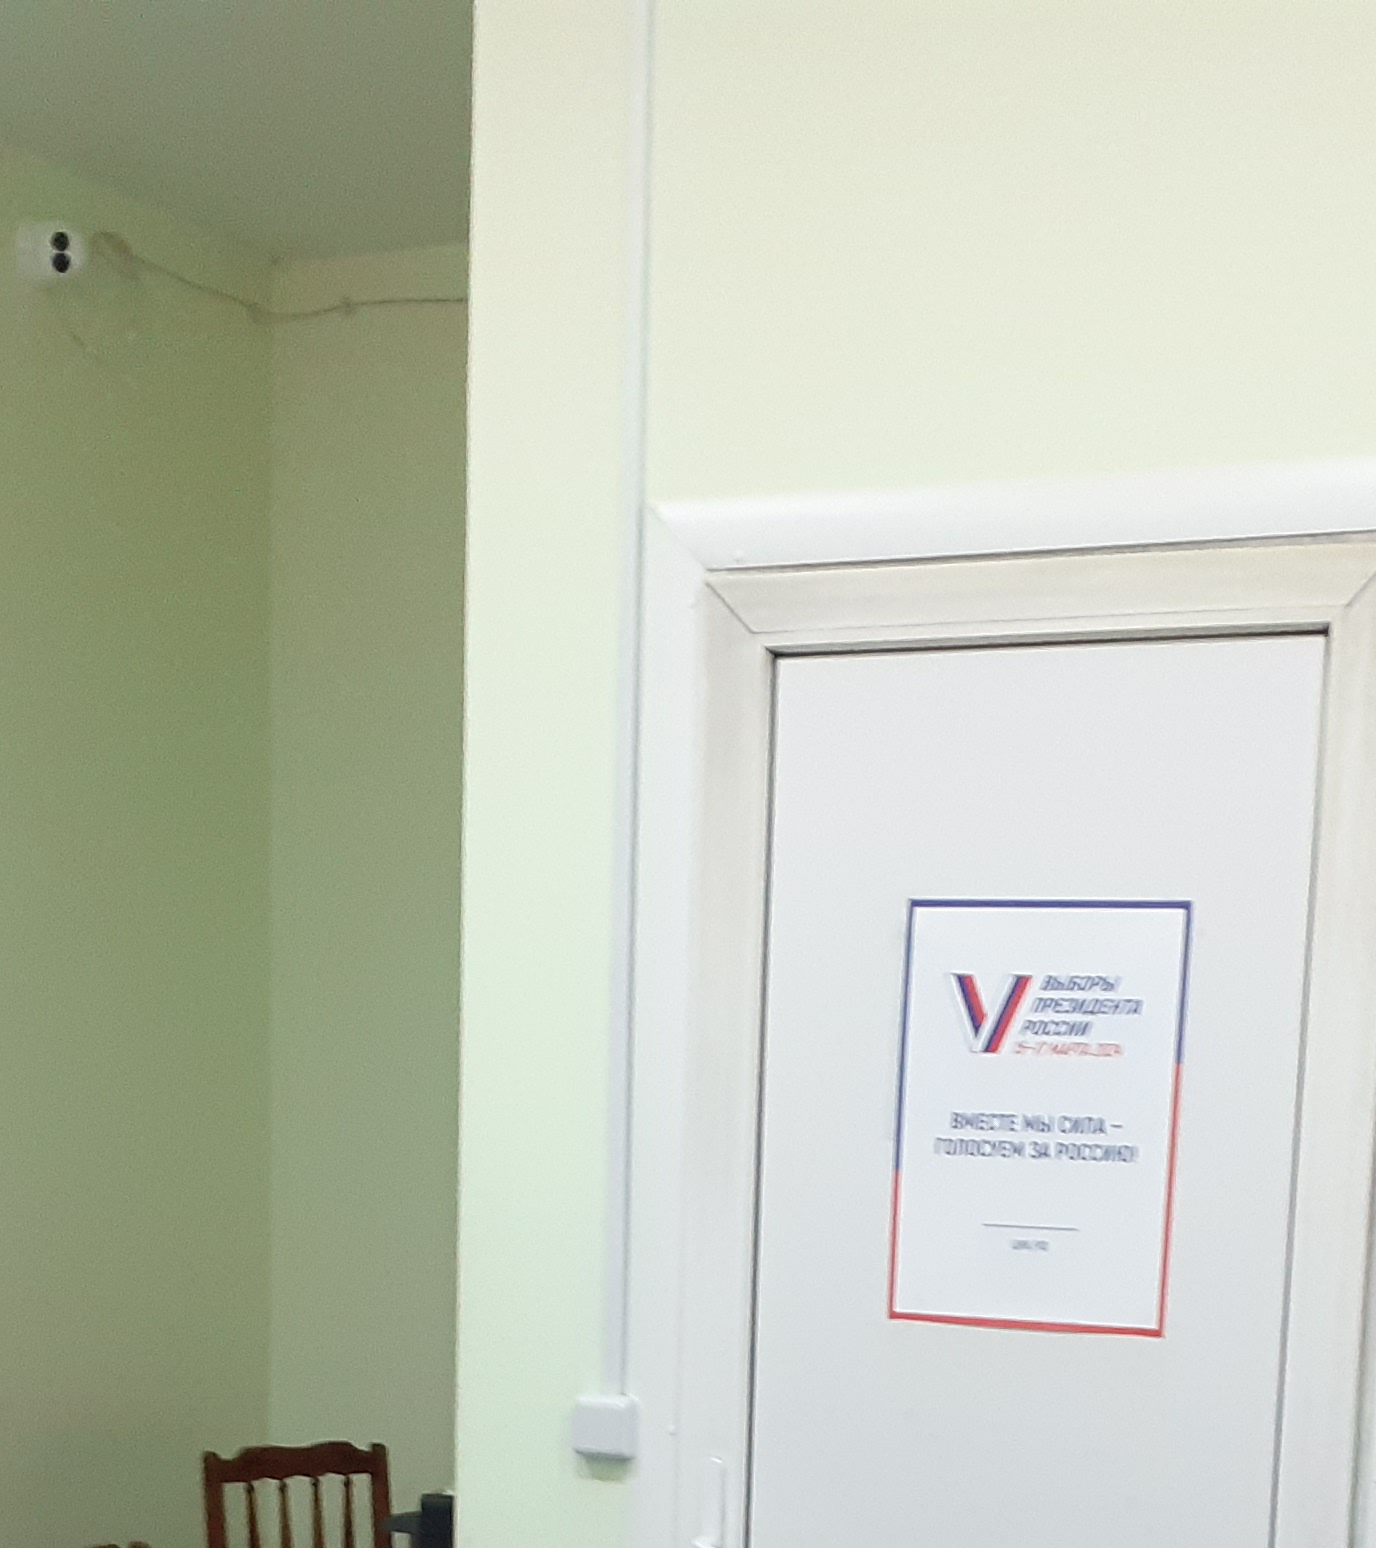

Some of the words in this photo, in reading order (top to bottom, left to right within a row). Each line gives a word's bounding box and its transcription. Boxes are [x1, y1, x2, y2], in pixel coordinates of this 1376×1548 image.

[1040, 974, 1120, 992] ВЫБОРЫ
[1030, 997, 1143, 1016] ПРЕЗИДЕНТА
[1021, 1019, 1092, 1037] РОССИИ
[950, 1111, 1019, 1132] ВМЕСТЕ
[1023, 1113, 1054, 1134] МЫ
[1057, 1115, 1107, 1136] СИЛА
[934, 1137, 1025, 1159] ГОЛОСУЕМ
[1028, 1140, 1052, 1159] ЗА
